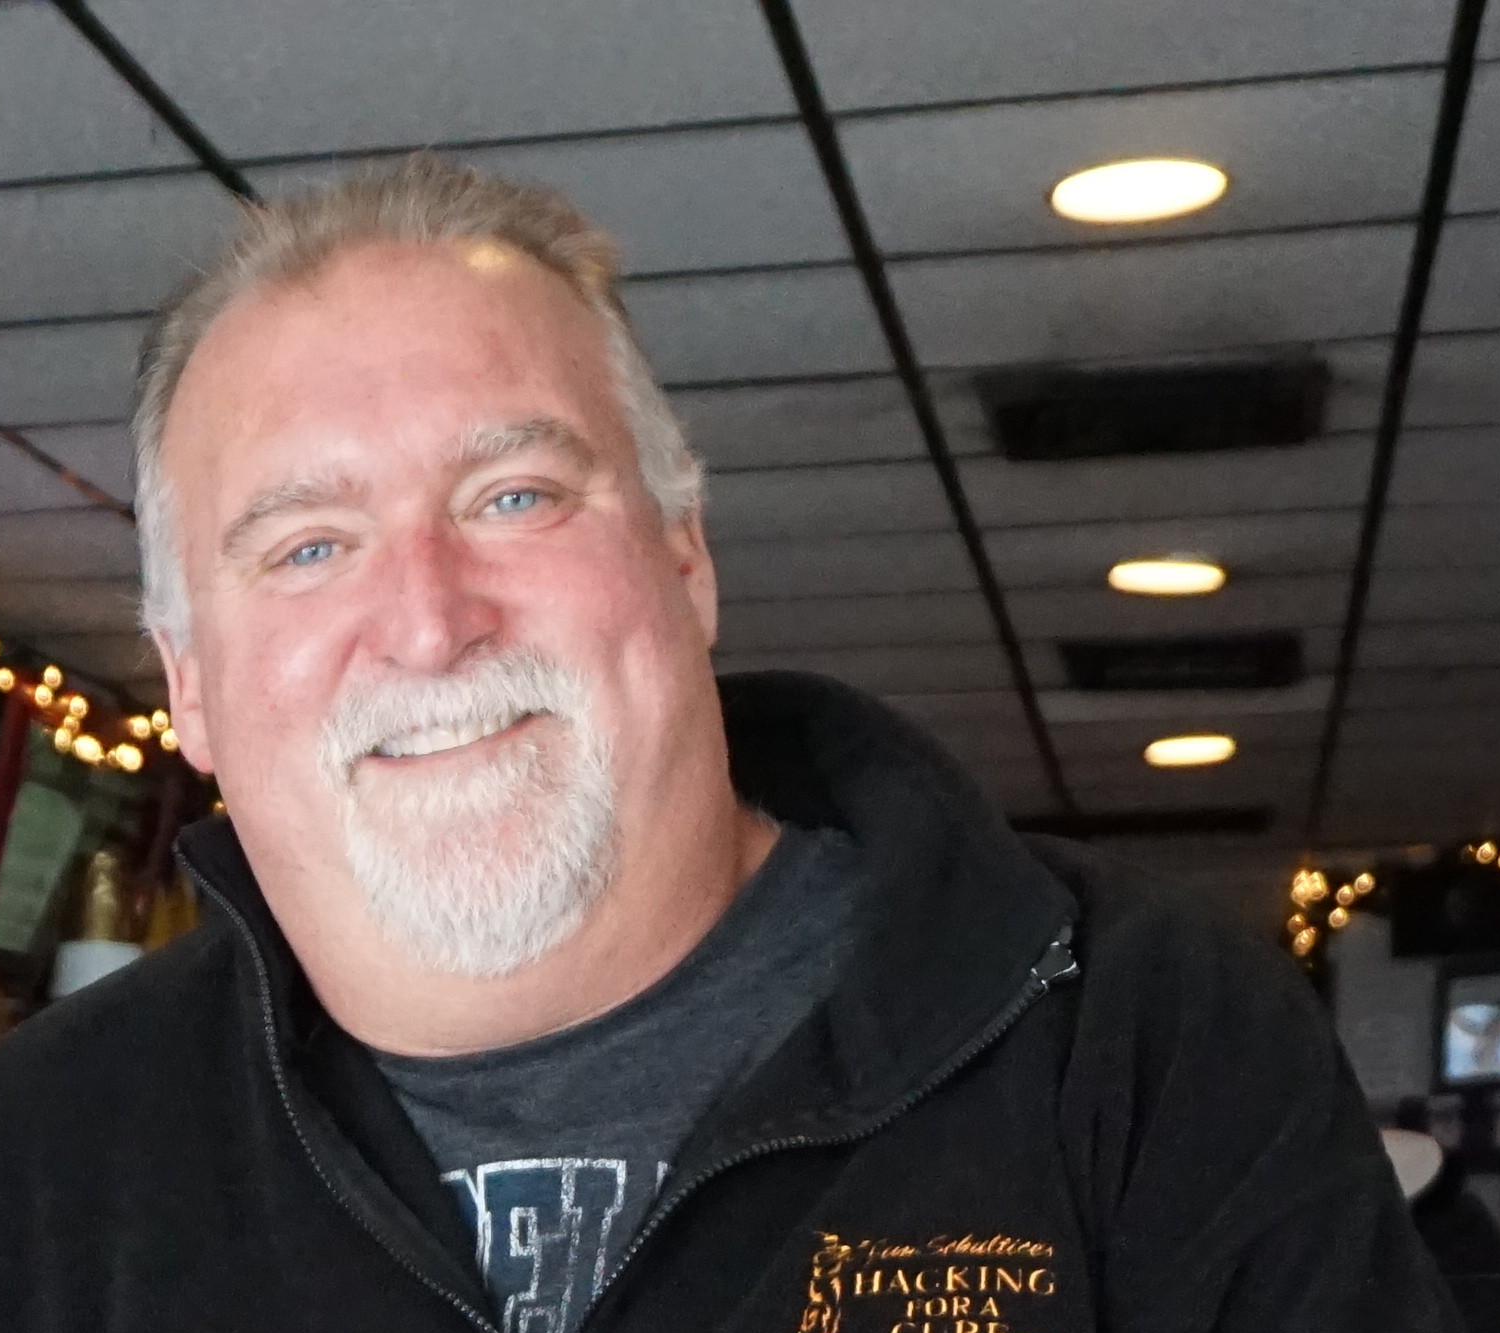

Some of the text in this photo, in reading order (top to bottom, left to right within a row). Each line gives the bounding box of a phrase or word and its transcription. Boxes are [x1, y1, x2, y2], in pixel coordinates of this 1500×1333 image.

[854, 1264, 1056, 1297] HACKING
[906, 1295, 1000, 1319] FOR A
